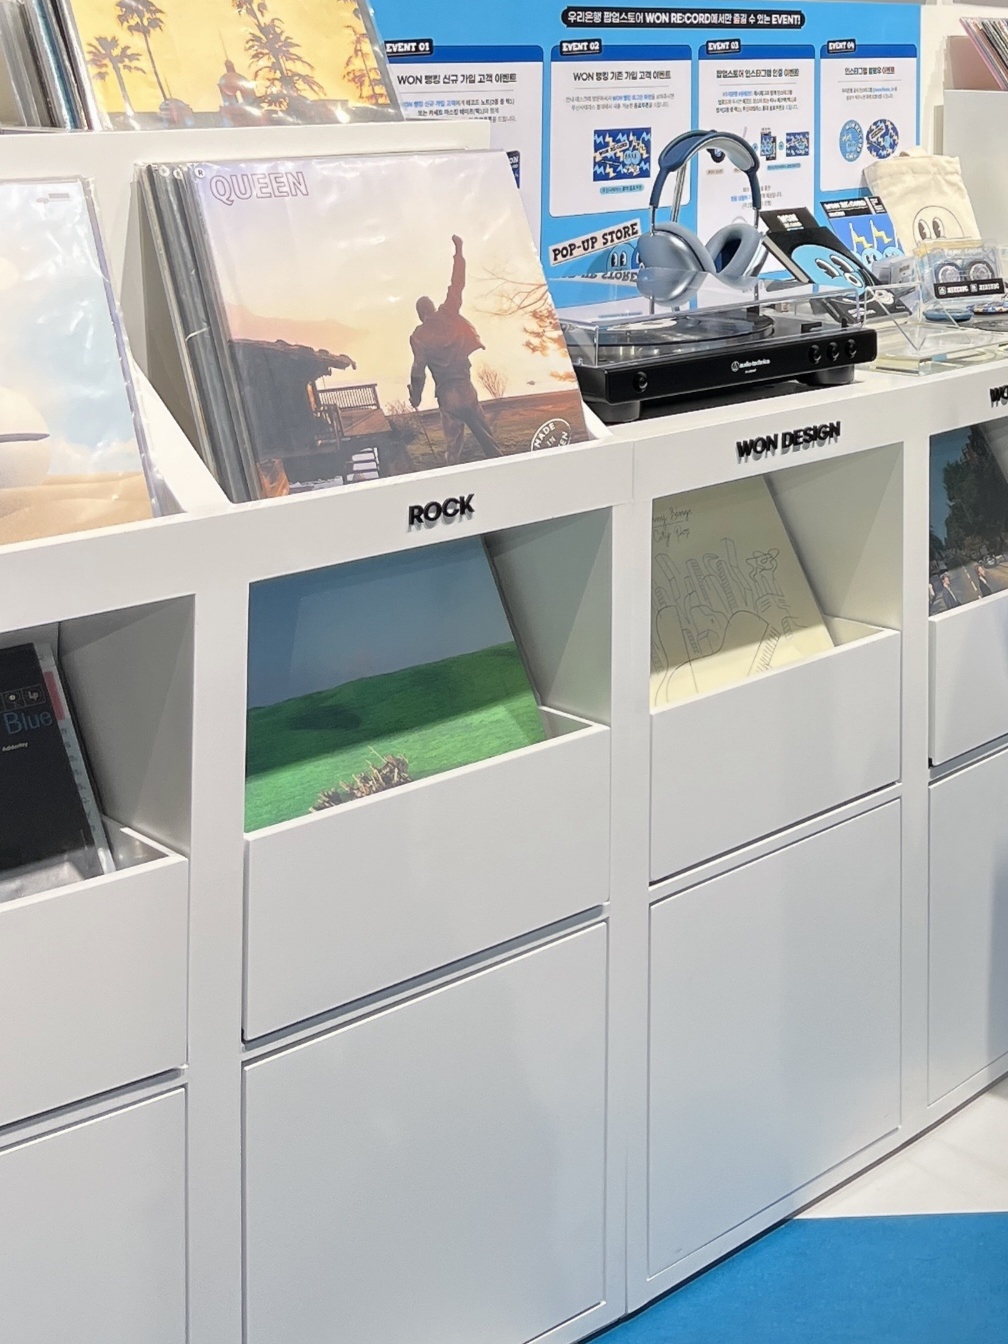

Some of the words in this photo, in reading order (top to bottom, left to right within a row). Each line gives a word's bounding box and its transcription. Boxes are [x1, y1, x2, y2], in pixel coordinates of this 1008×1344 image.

[568, 11, 602, 23] 우리은행
[604, 12, 644, 24] 팝업스토어
[645, 12, 670, 24] WON
[749, 14, 756, 24] 수
[757, 14, 770, 24] 있는
[772, 14, 801, 25] EVENT!
[386, 42, 416, 52] EVENT
[418, 42, 430, 52] 01
[562, 42, 588, 52] EVENT
[590, 42, 600, 50] 02
[708, 42, 730, 50] EVENT
[730, 42, 739, 50] 03
[828, 42, 846, 50] EVENT
[573, 72, 594, 82] WON
[610, 72, 623, 80] 기존
[625, 71, 637, 80] 가입
[639, 70, 652, 80] 고객
[716, 69, 744, 78] 팝업스토어
[745, 68, 772, 78] 인스타그램
[397, 74, 422, 85] WON
[424, 74, 440, 85] 뱅킹
[442, 74, 458, 84] 신규
[460, 74, 476, 84] 가입
[478, 74, 493, 84] 고객
[495, 74, 517, 83] 이벤트
[210, 172, 310, 206] QUEEN
[552, 236, 598, 262] POP-UP
[602, 222, 639, 246] STORE
[534, 422, 556, 448] MADE
[546, 436, 556, 446] IN
[736, 434, 778, 458] WON
[781, 420, 841, 449] DESIGN
[408, 493, 475, 526] ROCK
[4, 712, 52, 734] Blue
